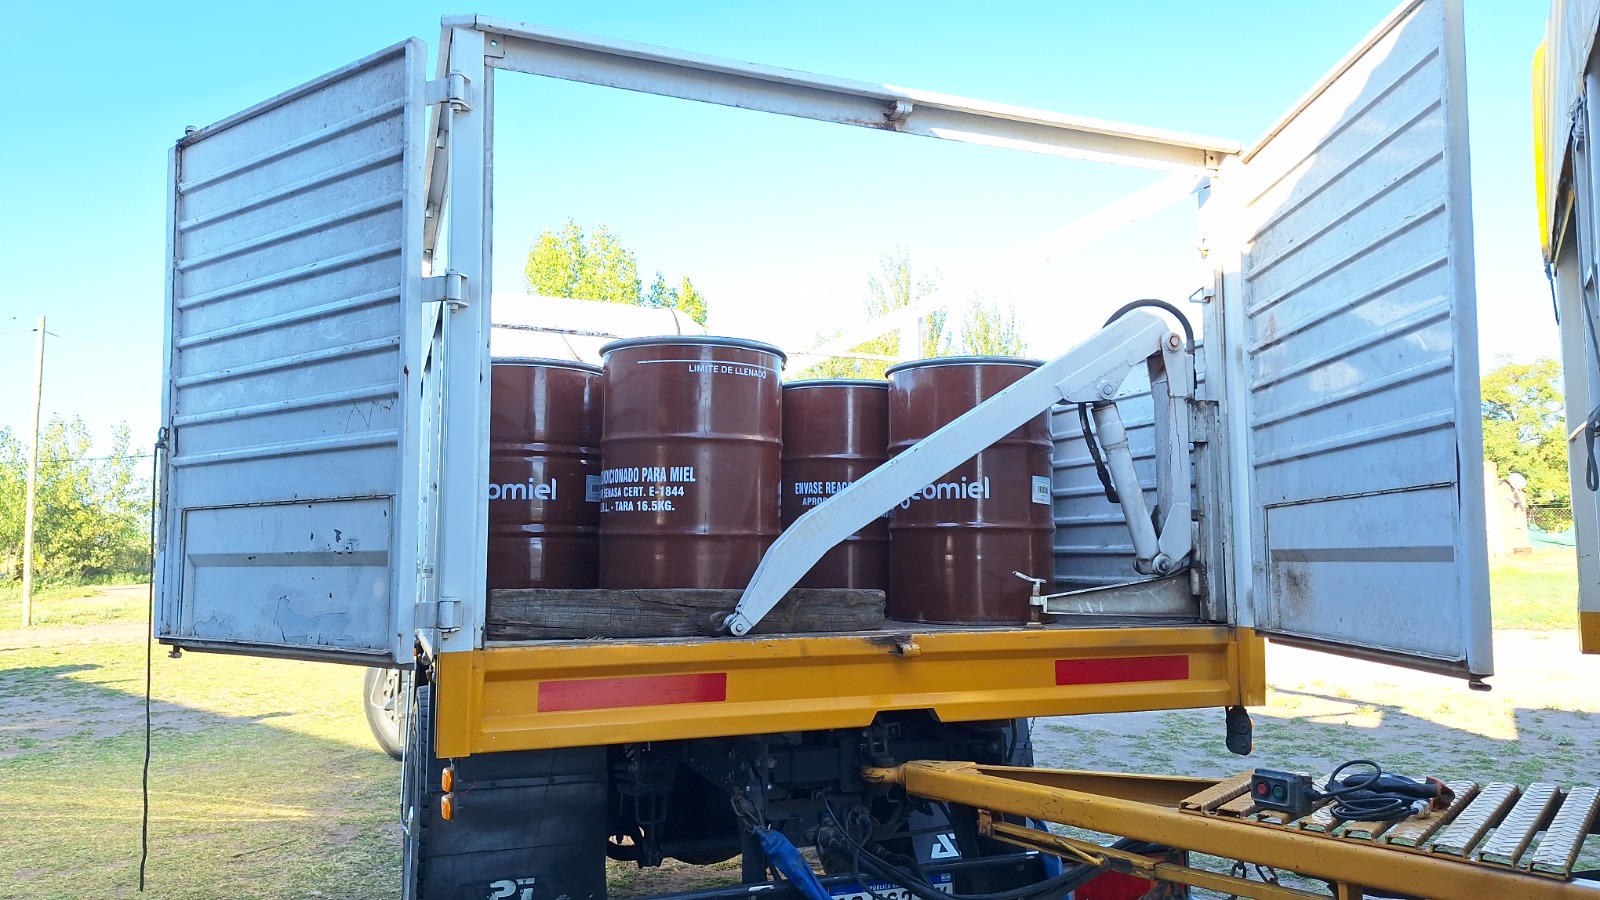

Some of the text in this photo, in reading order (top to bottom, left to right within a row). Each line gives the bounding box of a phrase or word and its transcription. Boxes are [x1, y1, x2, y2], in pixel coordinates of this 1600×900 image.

[688, 364, 767, 379] LIMITE DE LLENADO
[641, 466, 667, 482] PARA
[669, 466, 696, 482] MIEL
[488, 477, 557, 500] omiel
[623, 486, 646, 497] CERT.
[648, 485, 685, 497] E-1844
[795, 481, 853, 495] ENVASE REAC
[615, 501, 634, 511] TARA
[636, 500, 675, 511] 16.5KG.
